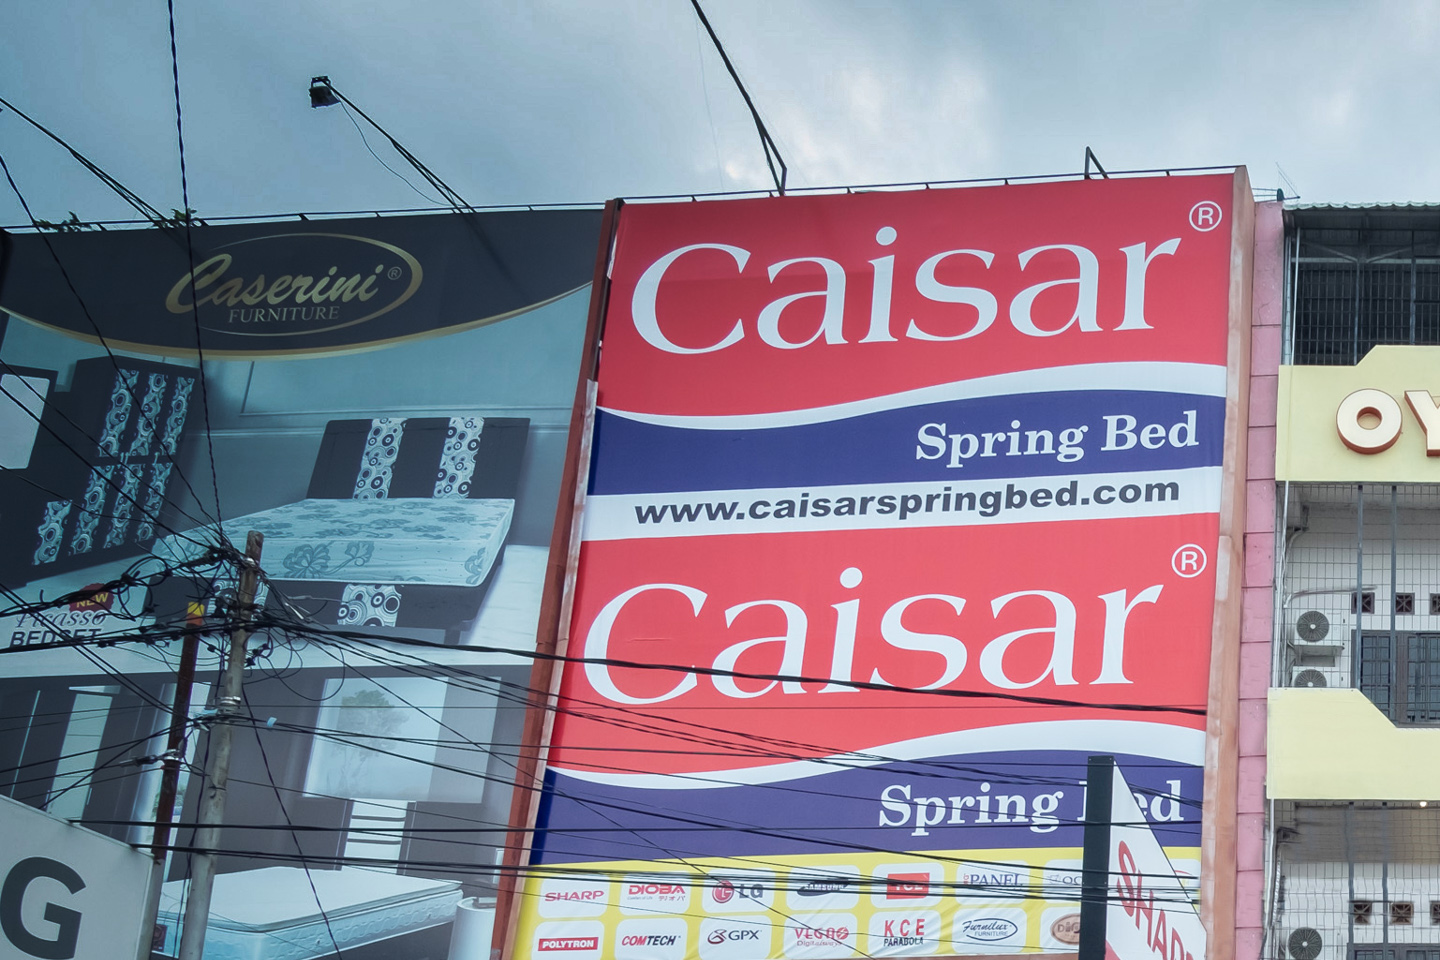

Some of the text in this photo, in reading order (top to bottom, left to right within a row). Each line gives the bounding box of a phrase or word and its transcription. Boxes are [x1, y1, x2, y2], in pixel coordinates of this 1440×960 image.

[165, 253, 384, 312] Caserini
[631, 225, 1182, 355] Caisar
[227, 306, 341, 324] FURNITURE
[915, 410, 1200, 469] Spring Bed
[634, 479, 1180, 526] www.caisarspringbed.com
[583, 566, 1164, 706] Caisar
[879, 781, 1064, 835] Spring
[544, 890, 605, 902] SHARP
[628, 884, 686, 895] DIOBA
[739, 883, 764, 899] LG
[621, 935, 677, 946] COMTECH
[728, 929, 760, 941] GPX
[883, 936, 924, 948] PARABOLA
[542, 939, 594, 949] POLYTRON
